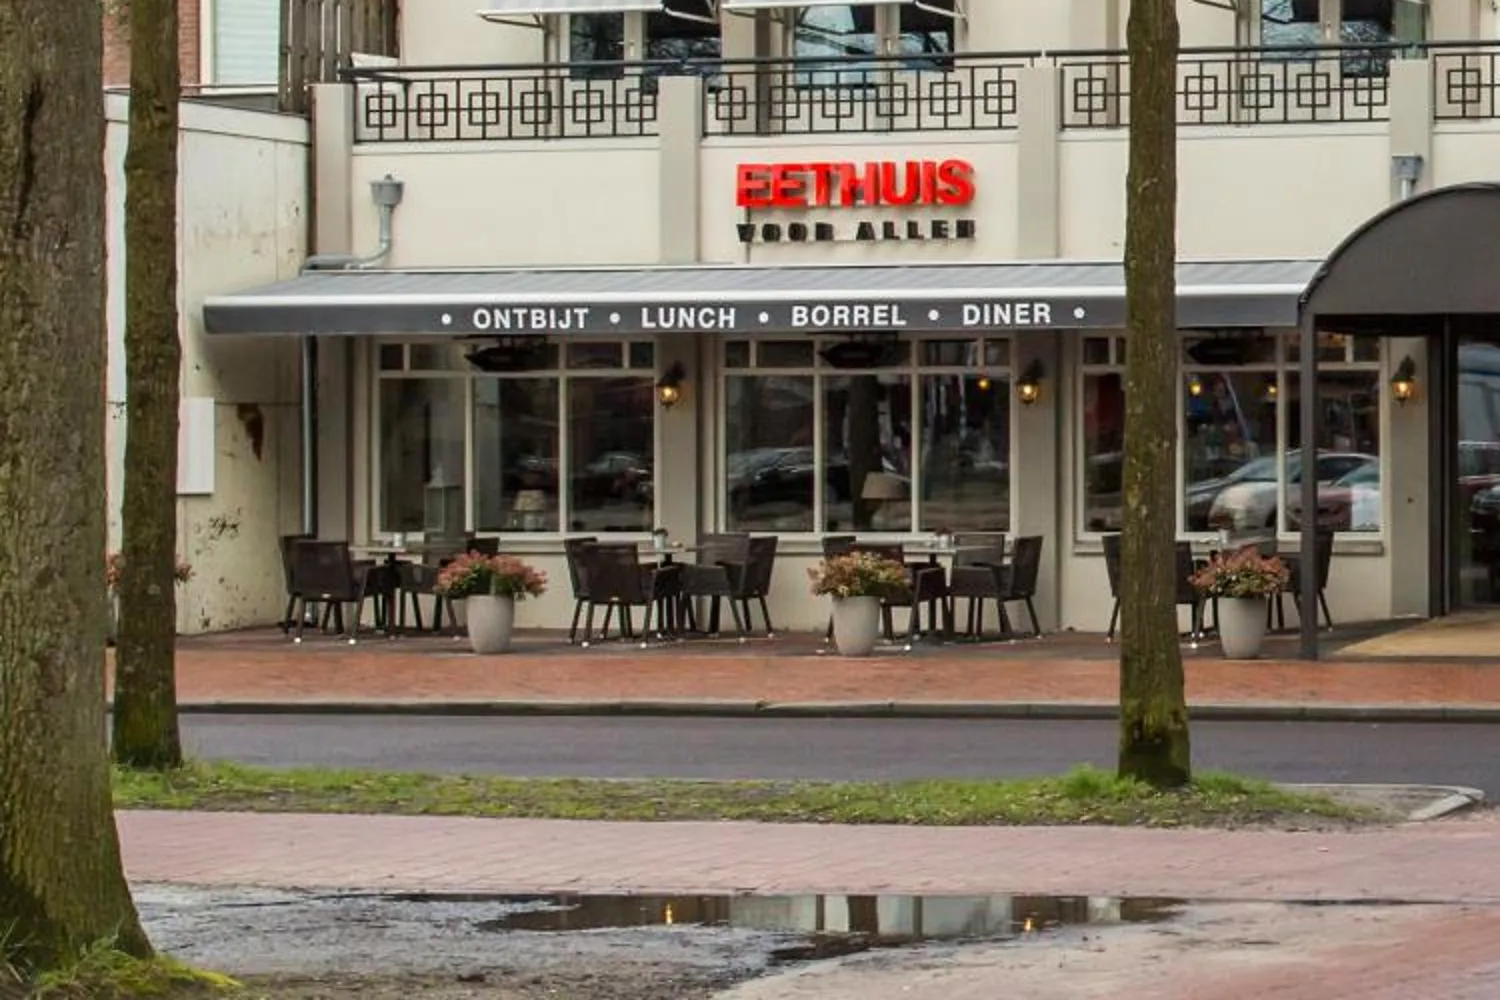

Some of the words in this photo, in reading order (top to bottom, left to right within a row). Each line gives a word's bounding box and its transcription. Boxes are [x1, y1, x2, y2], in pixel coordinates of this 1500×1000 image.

[736, 159, 976, 207] EETHUIS
[737, 222, 834, 242] VOOR
[473, 308, 589, 330] ONTBIJT
[641, 307, 736, 329] LUNCH
[791, 304, 907, 327] BORREL
[963, 302, 1051, 326] DINER
